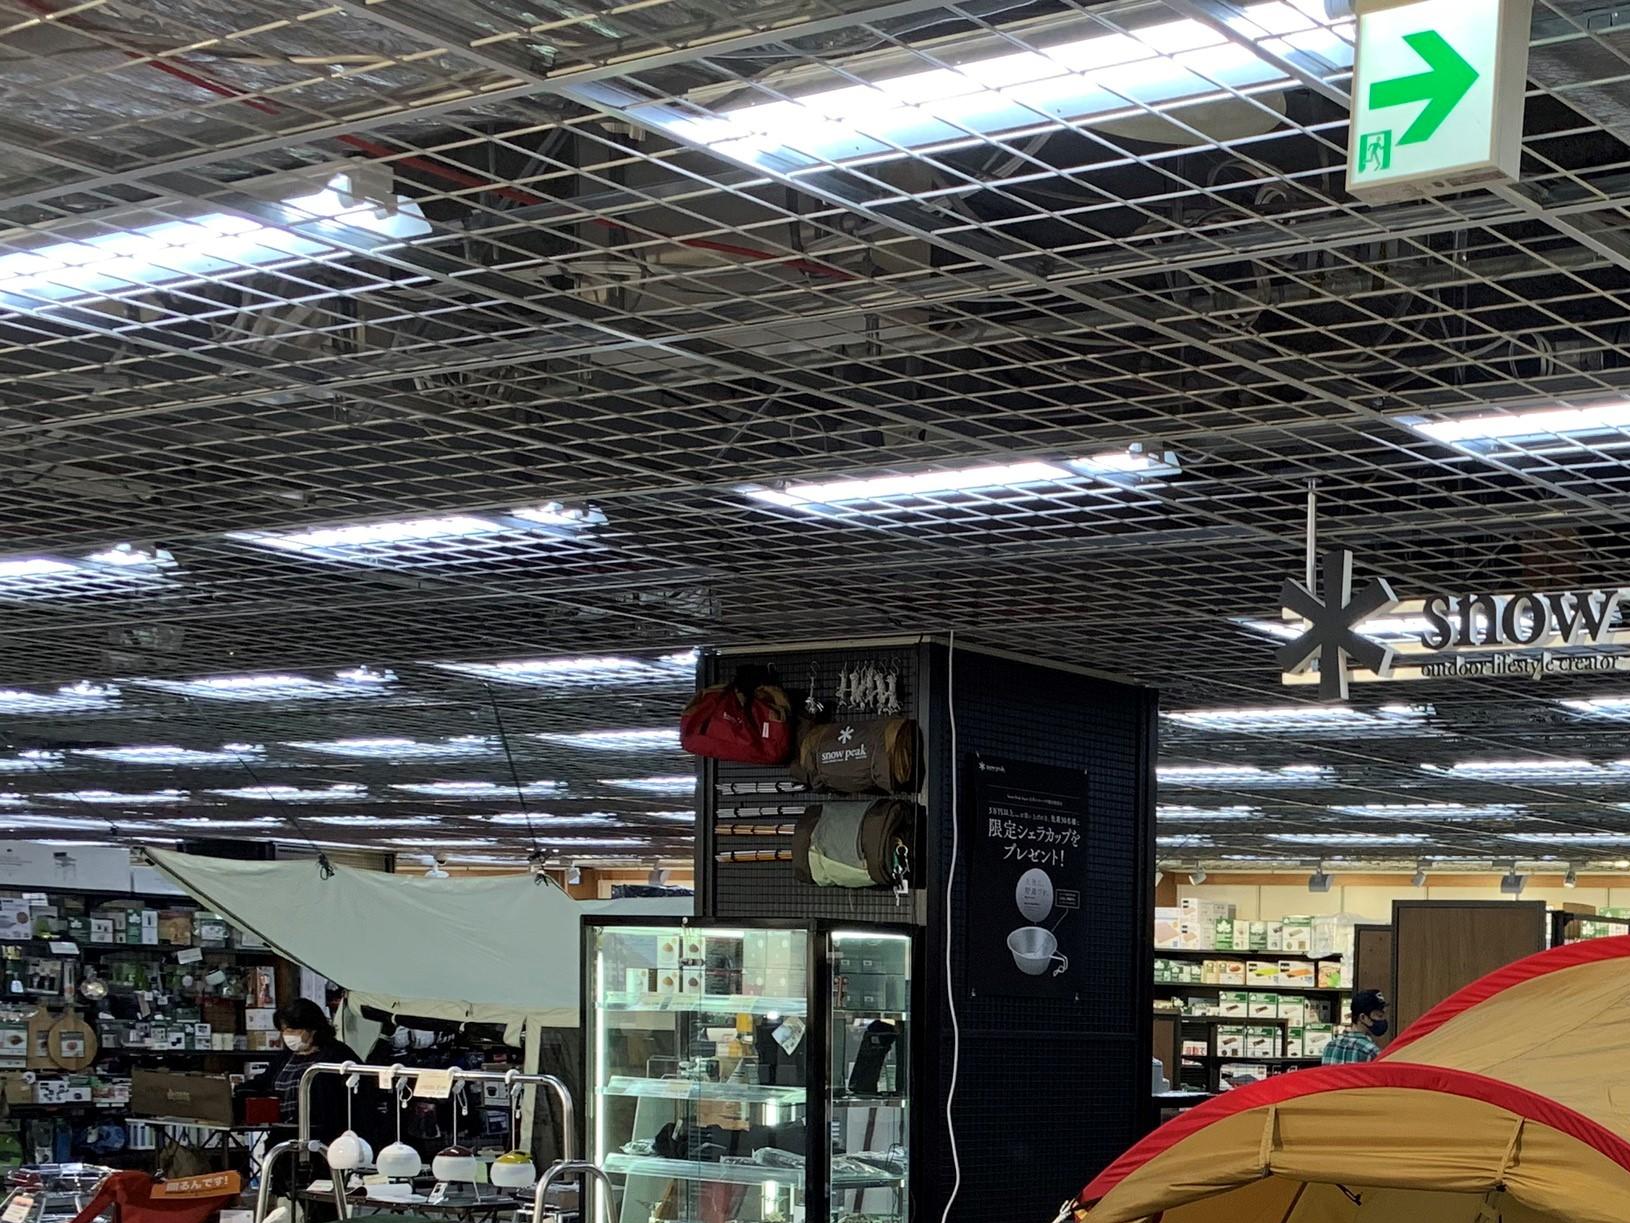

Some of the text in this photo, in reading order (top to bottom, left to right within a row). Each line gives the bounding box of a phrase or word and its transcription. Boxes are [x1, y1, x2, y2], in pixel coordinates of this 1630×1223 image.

[1421, 588, 1620, 650] snow
[1421, 651, 1620, 680] outdoor lifestyle creator
[821, 743, 866, 761] snow peak
[988, 817, 1081, 848] 限定シェラカップを
